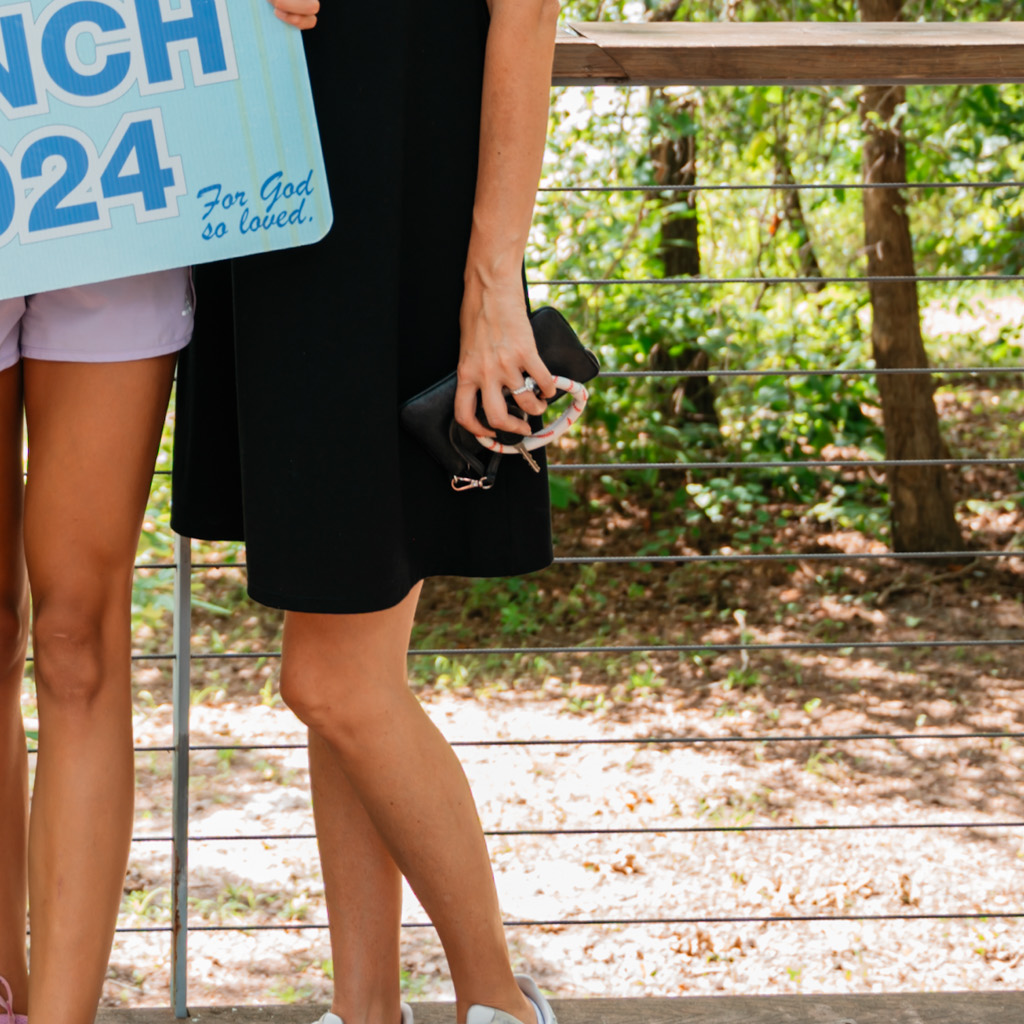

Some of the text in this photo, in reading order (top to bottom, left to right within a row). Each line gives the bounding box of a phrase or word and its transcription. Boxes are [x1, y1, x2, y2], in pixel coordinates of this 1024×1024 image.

[196, 168, 314, 221] For God
[201, 197, 313, 241] so loved.
